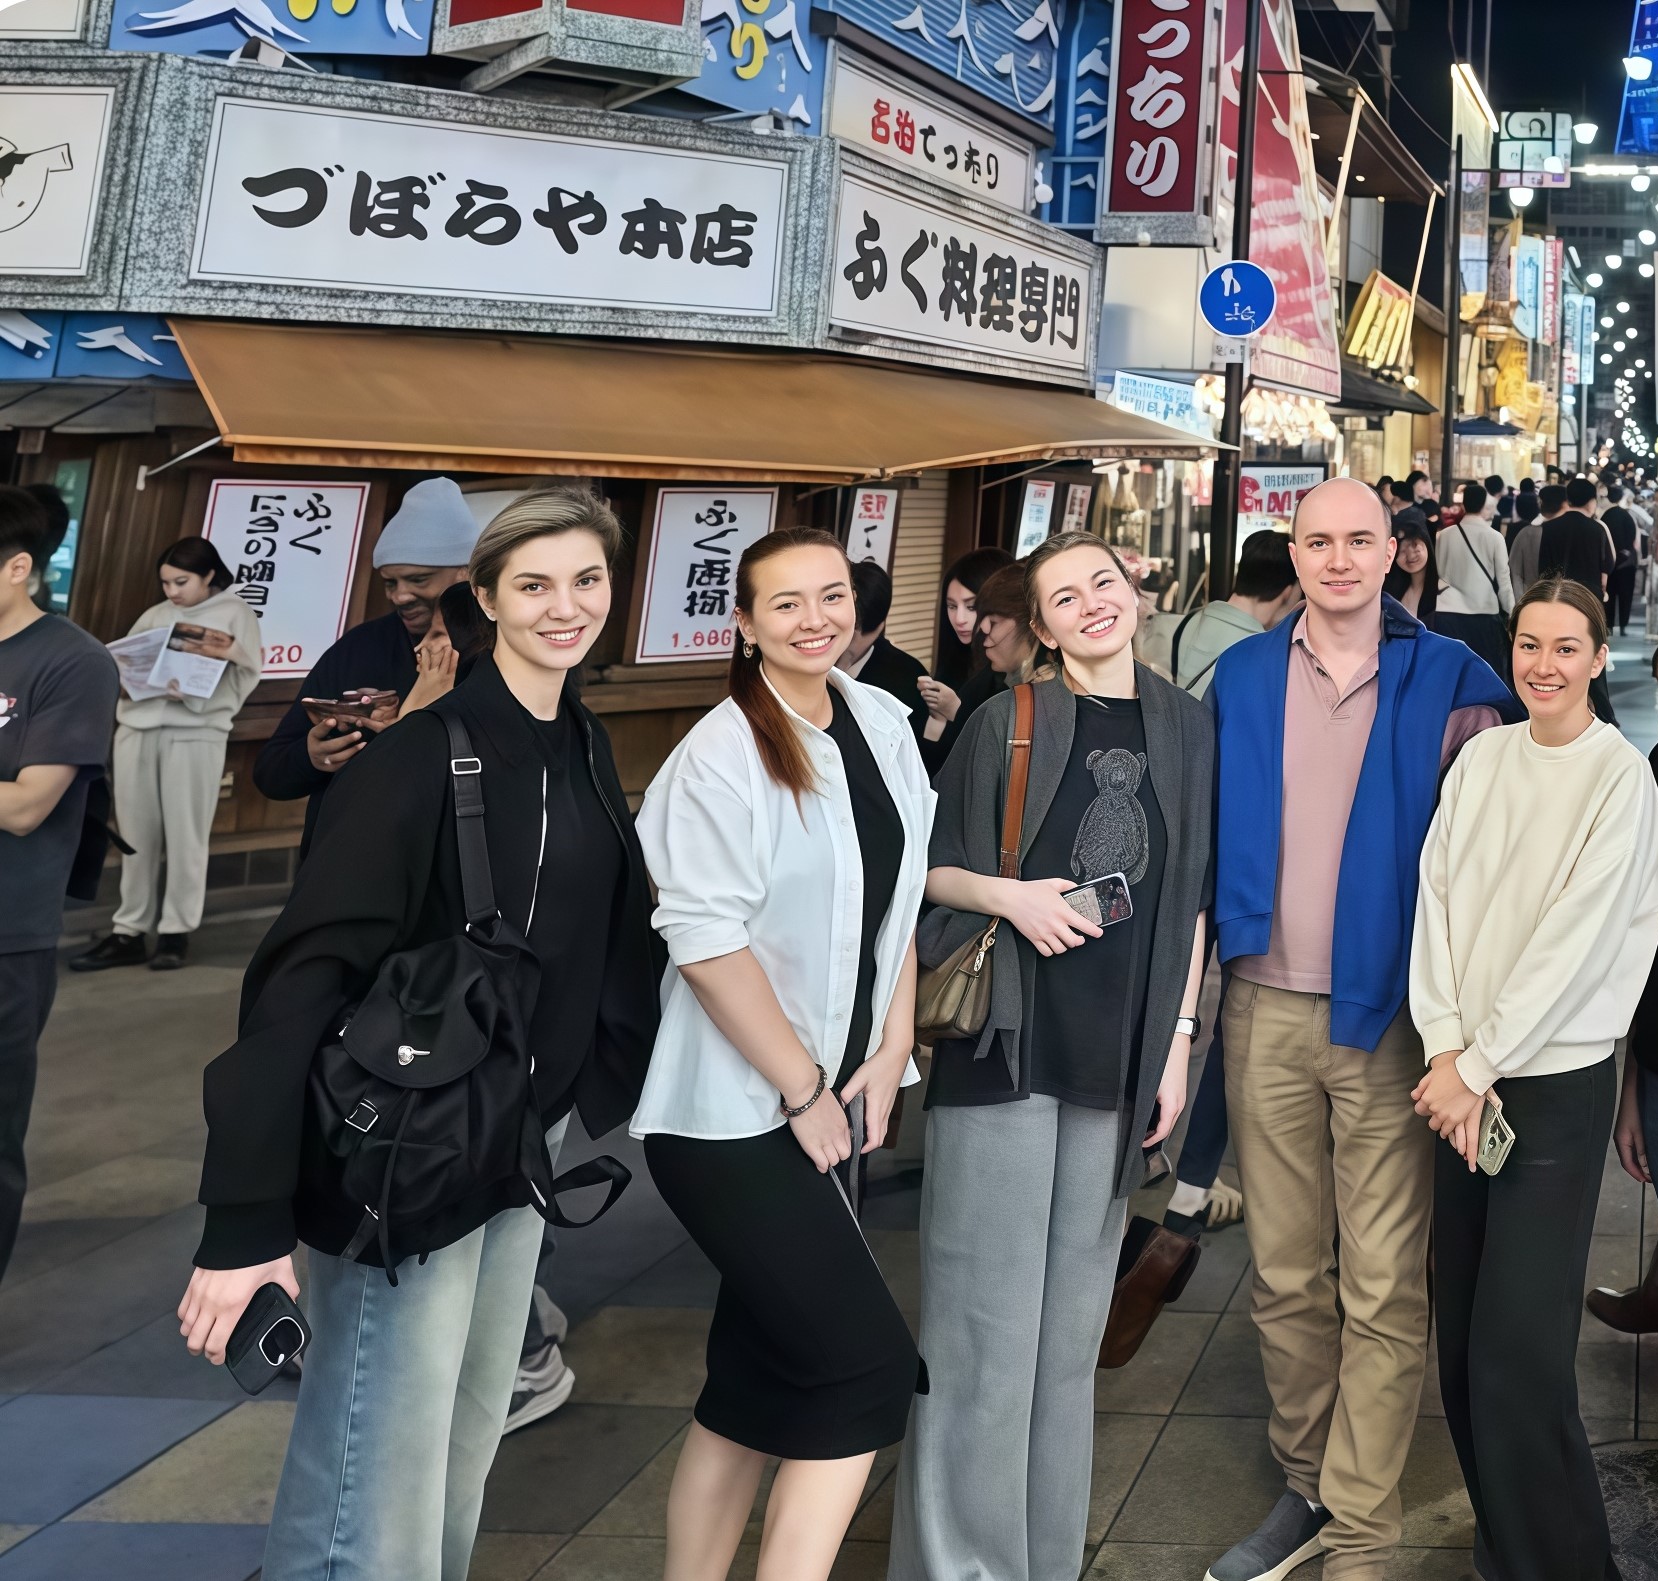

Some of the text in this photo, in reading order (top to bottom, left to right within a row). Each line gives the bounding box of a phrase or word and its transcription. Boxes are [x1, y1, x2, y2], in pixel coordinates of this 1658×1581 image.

[1125, 0, 1192, 197] っちり
[242, 164, 758, 269] づぼらや本店
[843, 210, 1081, 350] ふぐ料理専門
